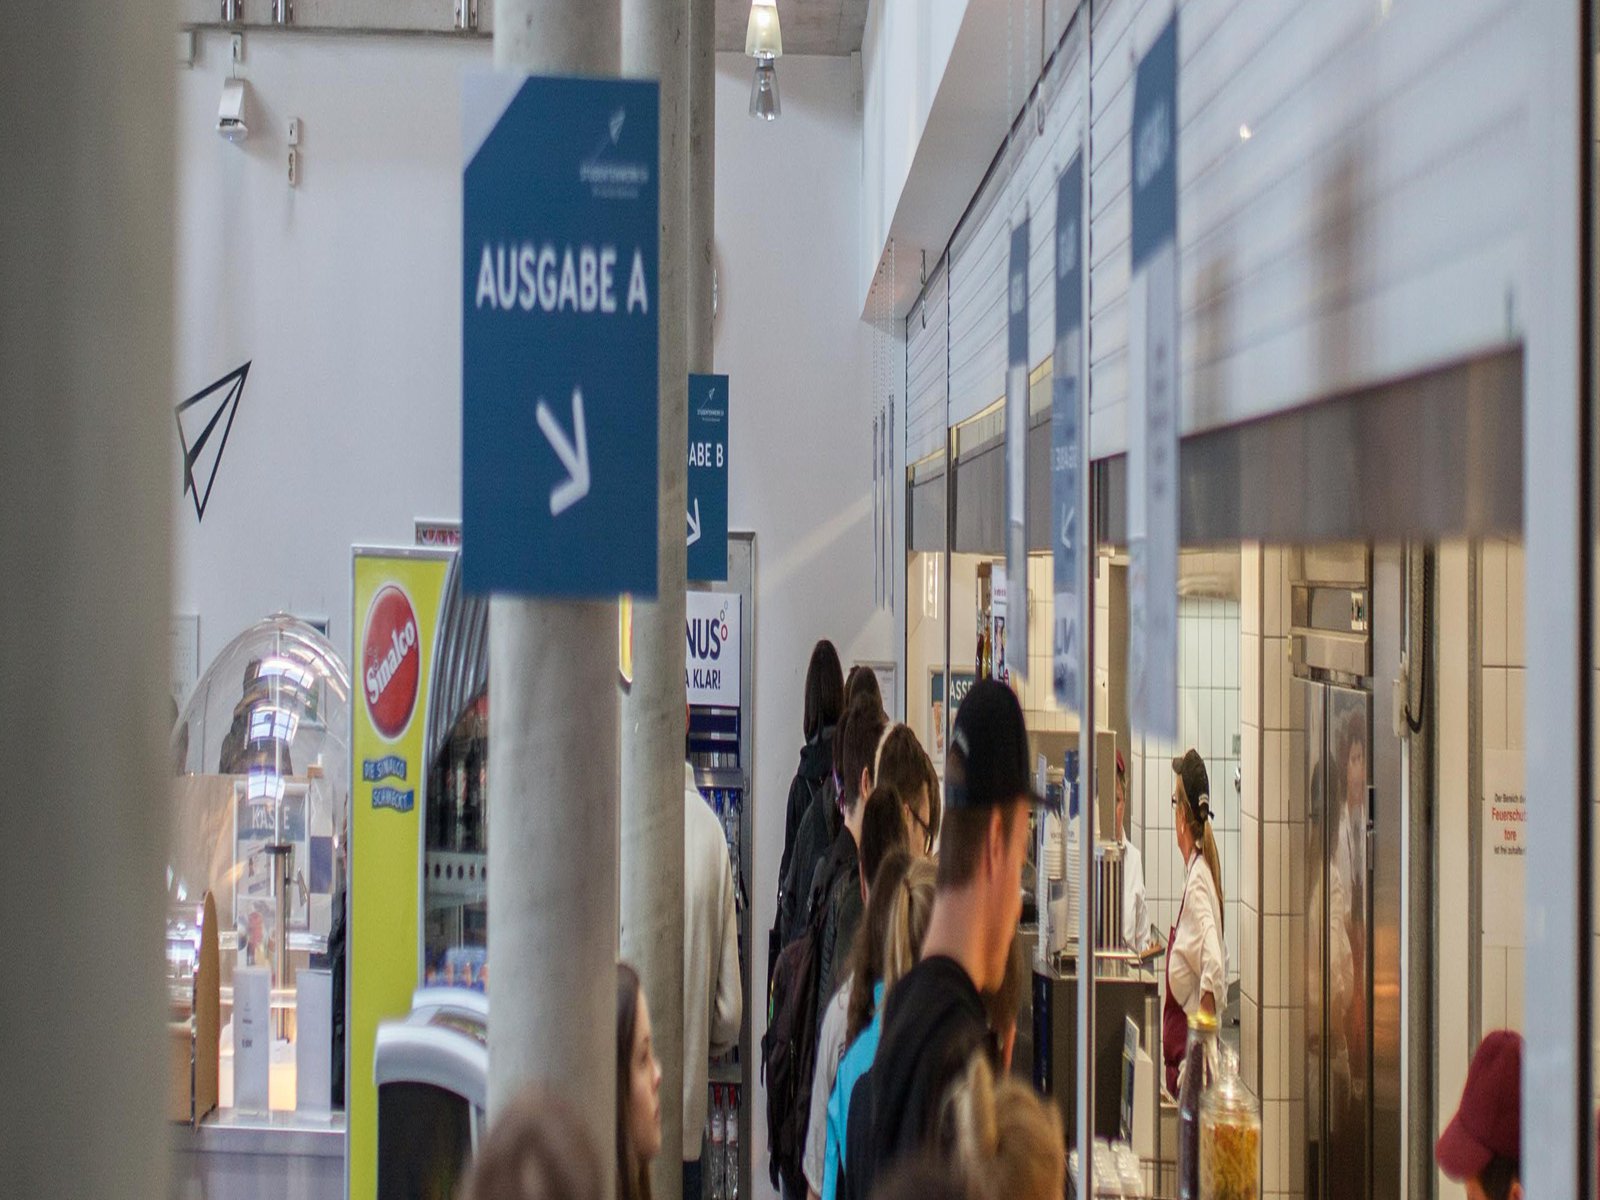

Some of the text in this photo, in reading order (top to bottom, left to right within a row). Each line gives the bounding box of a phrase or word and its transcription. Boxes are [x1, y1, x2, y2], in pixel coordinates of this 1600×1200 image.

[475, 242, 649, 316] AUSGABE A
[688, 442, 724, 468] ABE B
[686, 617, 721, 661] NUS
[366, 621, 415, 705] Sinalco
[693, 668, 721, 691] KLAR!
[252, 804, 290, 830] KASE
